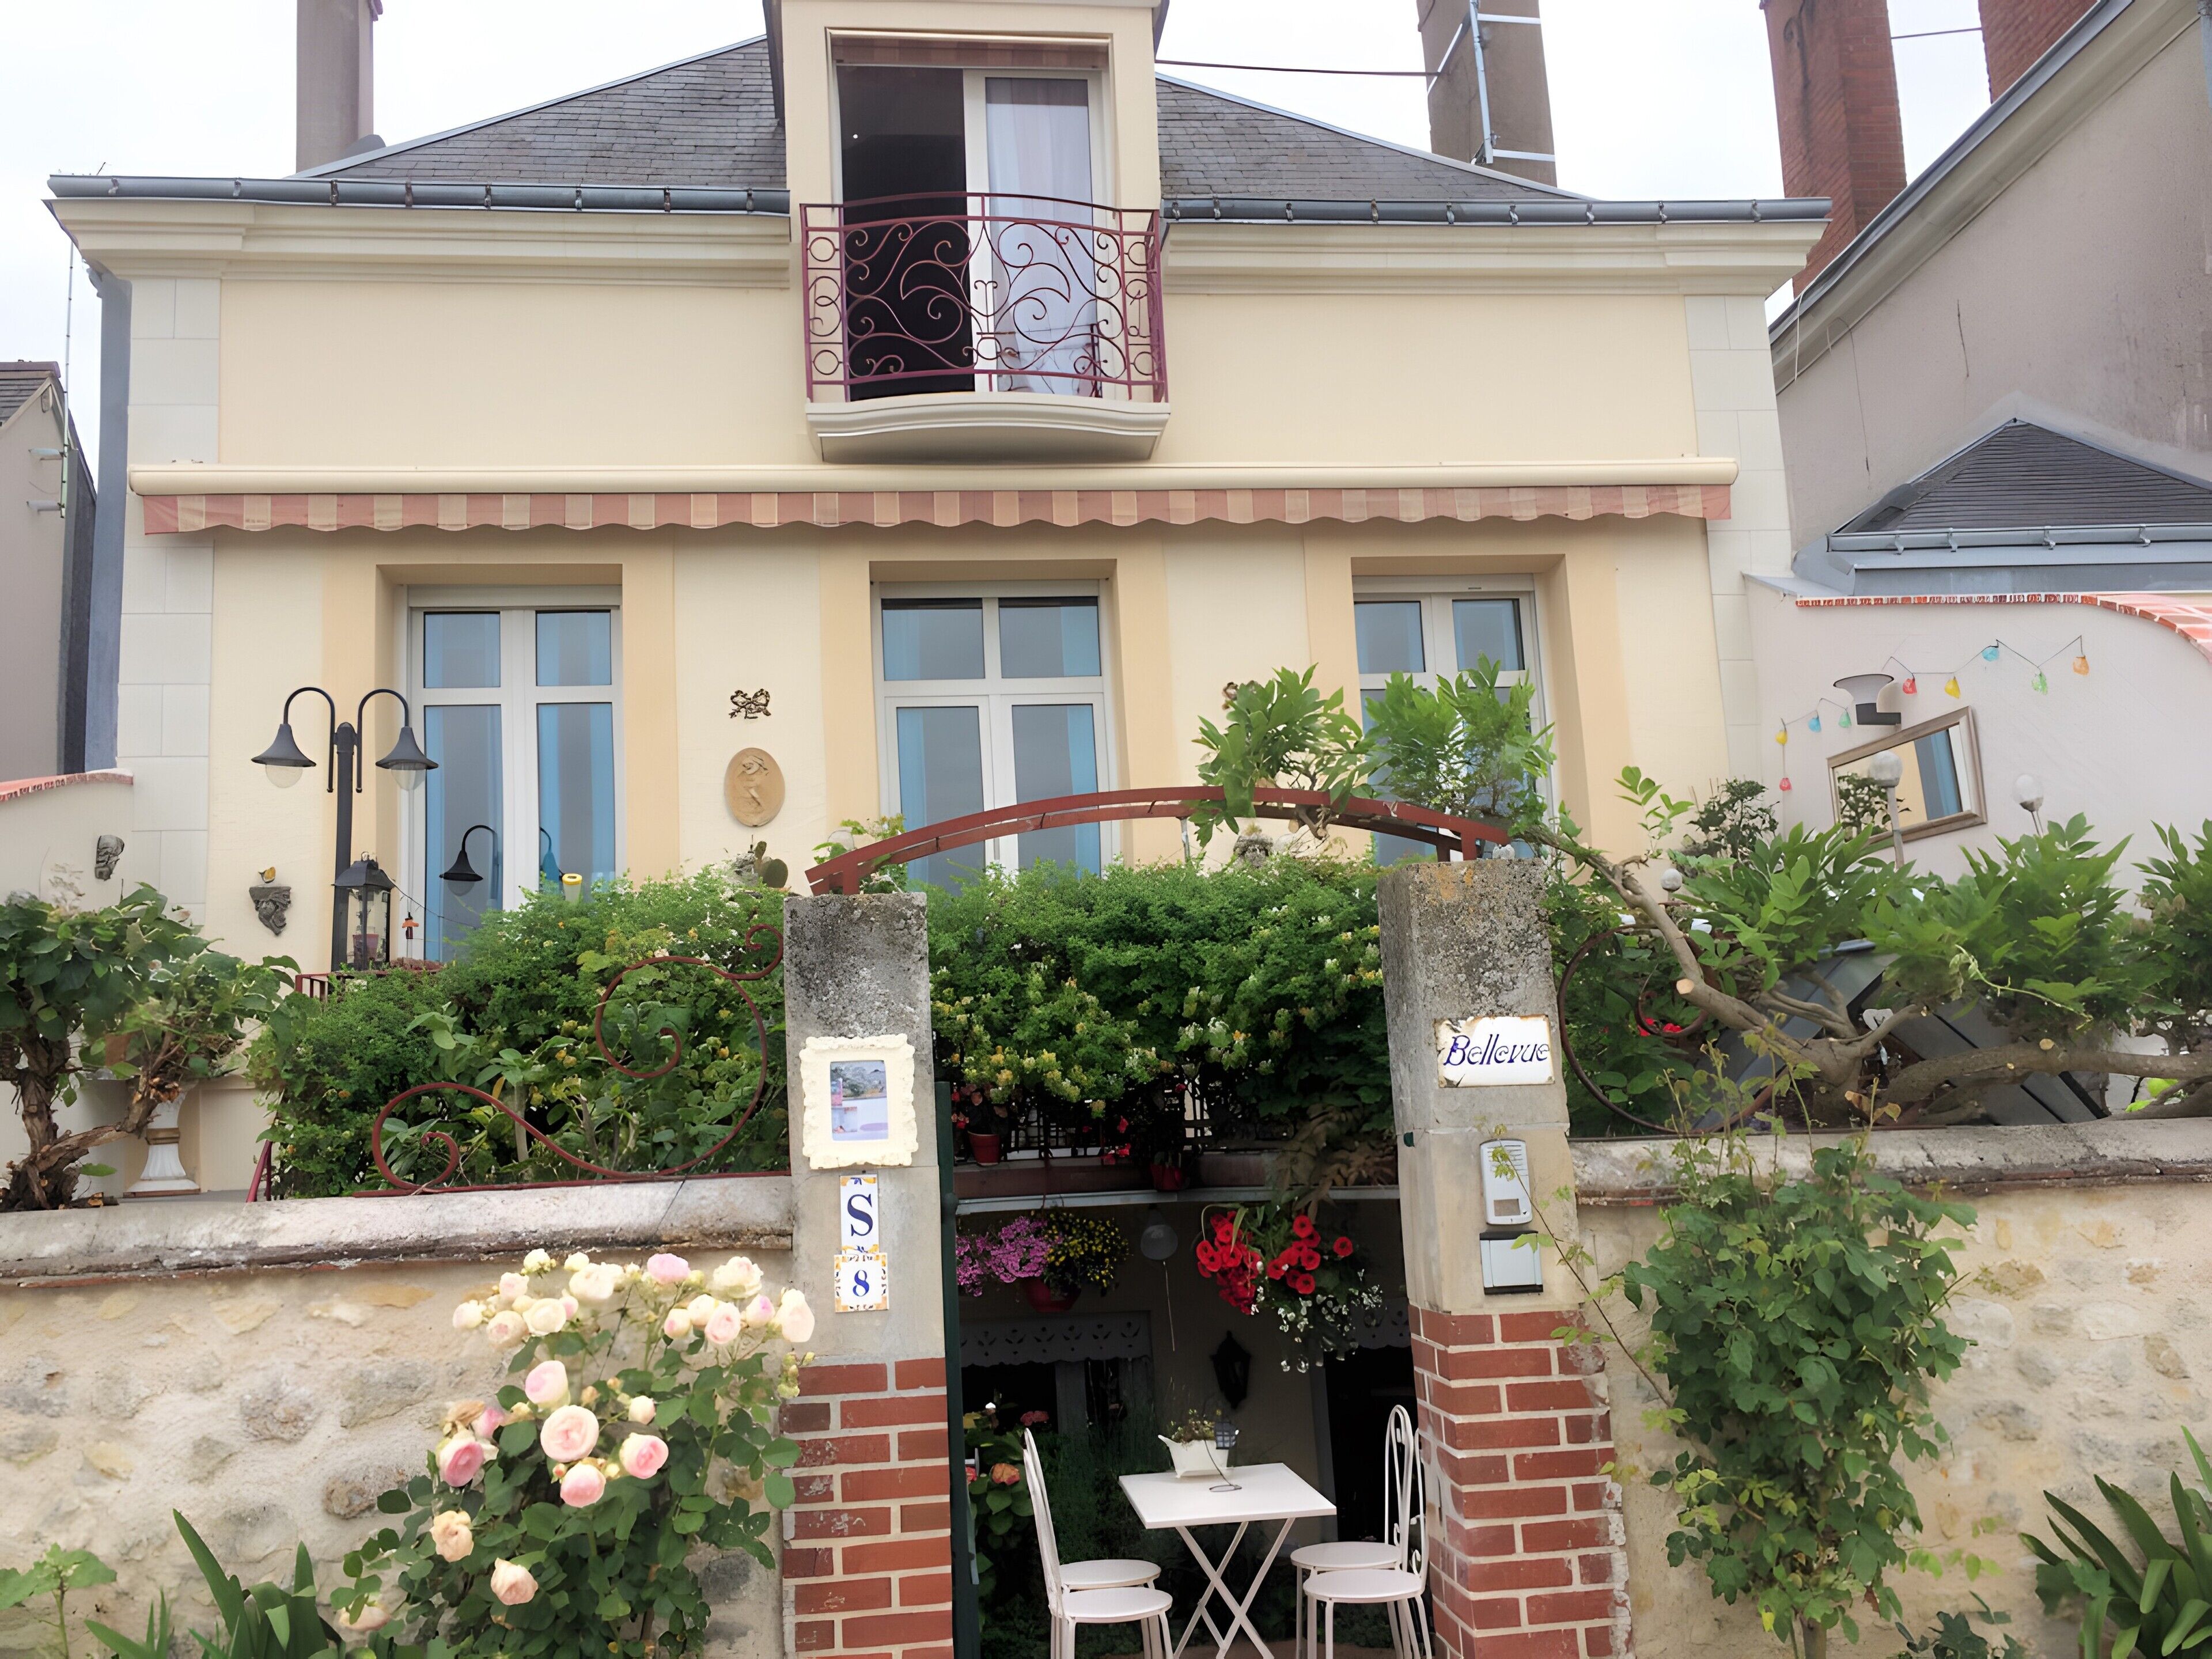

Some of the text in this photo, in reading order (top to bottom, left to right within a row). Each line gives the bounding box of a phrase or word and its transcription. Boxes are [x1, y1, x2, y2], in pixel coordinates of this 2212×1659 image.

[1444, 1034, 1550, 1065] Bellevue
[847, 1194, 873, 1237] S
[853, 1270, 870, 1297] 8
